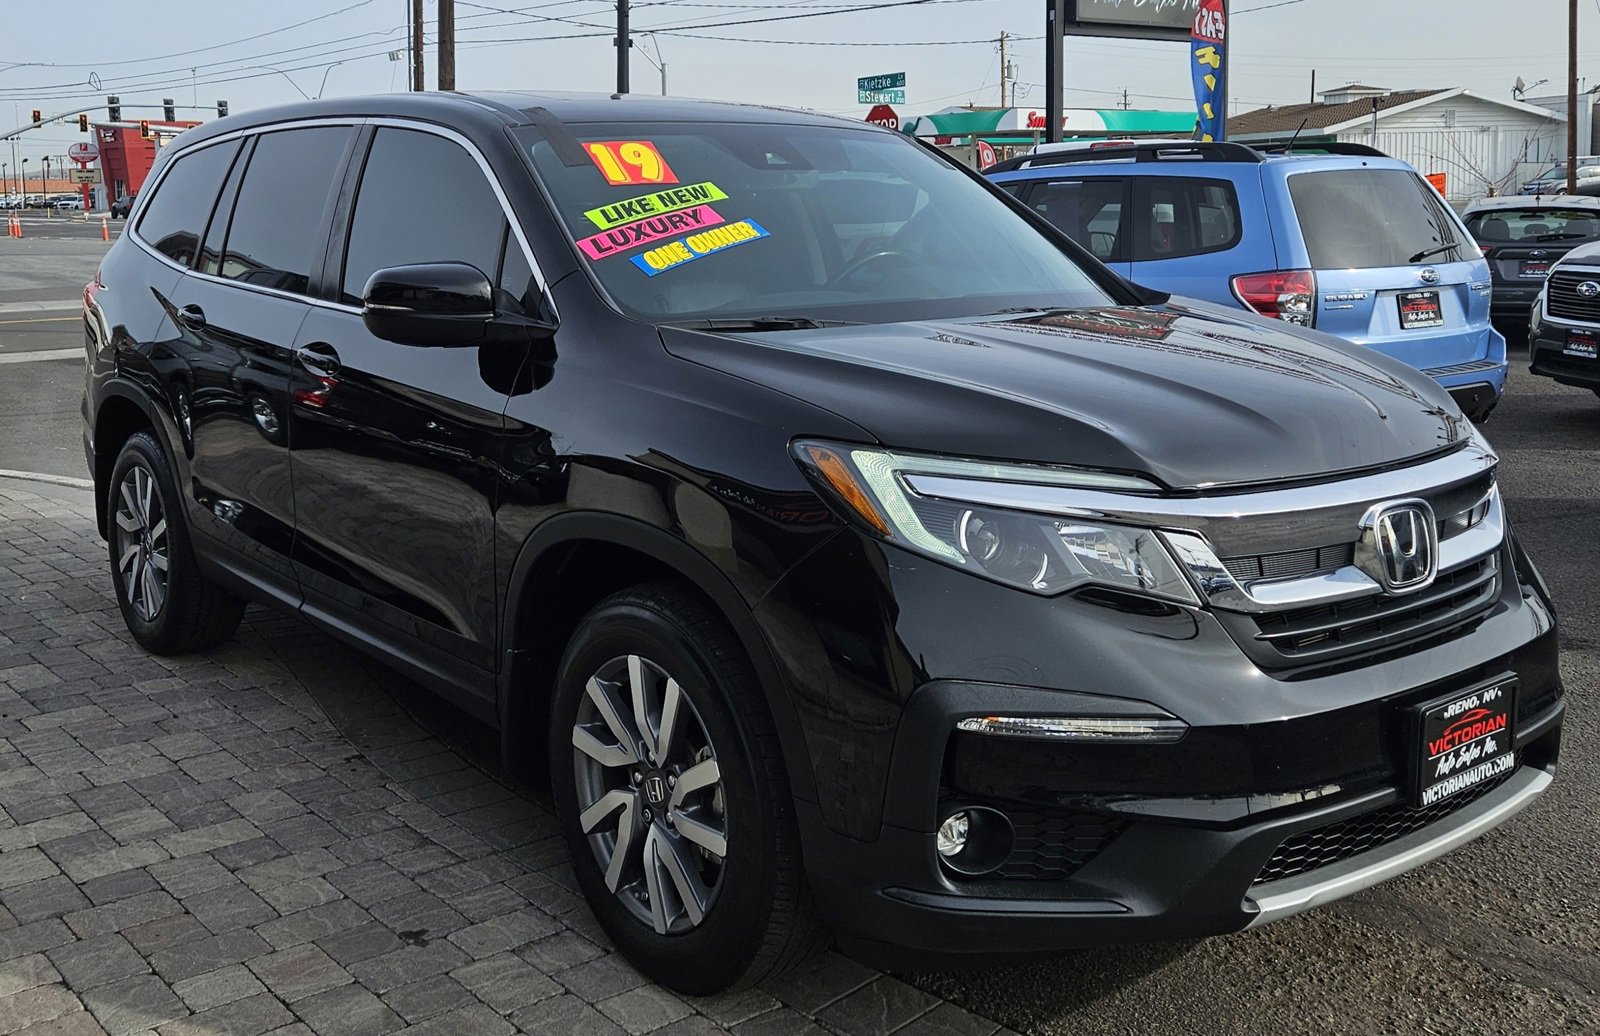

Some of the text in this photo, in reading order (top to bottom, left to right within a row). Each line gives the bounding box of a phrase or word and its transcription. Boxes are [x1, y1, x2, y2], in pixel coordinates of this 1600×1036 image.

[864, 76, 891, 89] Kietzke
[865, 91, 895, 103] Stewart
[589, 142, 664, 182] 19
[599, 184, 711, 224] LIKE NEW
[589, 208, 704, 253] LUXURY
[643, 221, 760, 270] ONE OWNER
[1446, 687, 1498, 717] RENO, NV
[1428, 713, 1507, 755] VICTORIAN
[1435, 736, 1498, 778] Auto Sales Inc.
[1422, 752, 1515, 806] VICTORIANAUTO.COM
